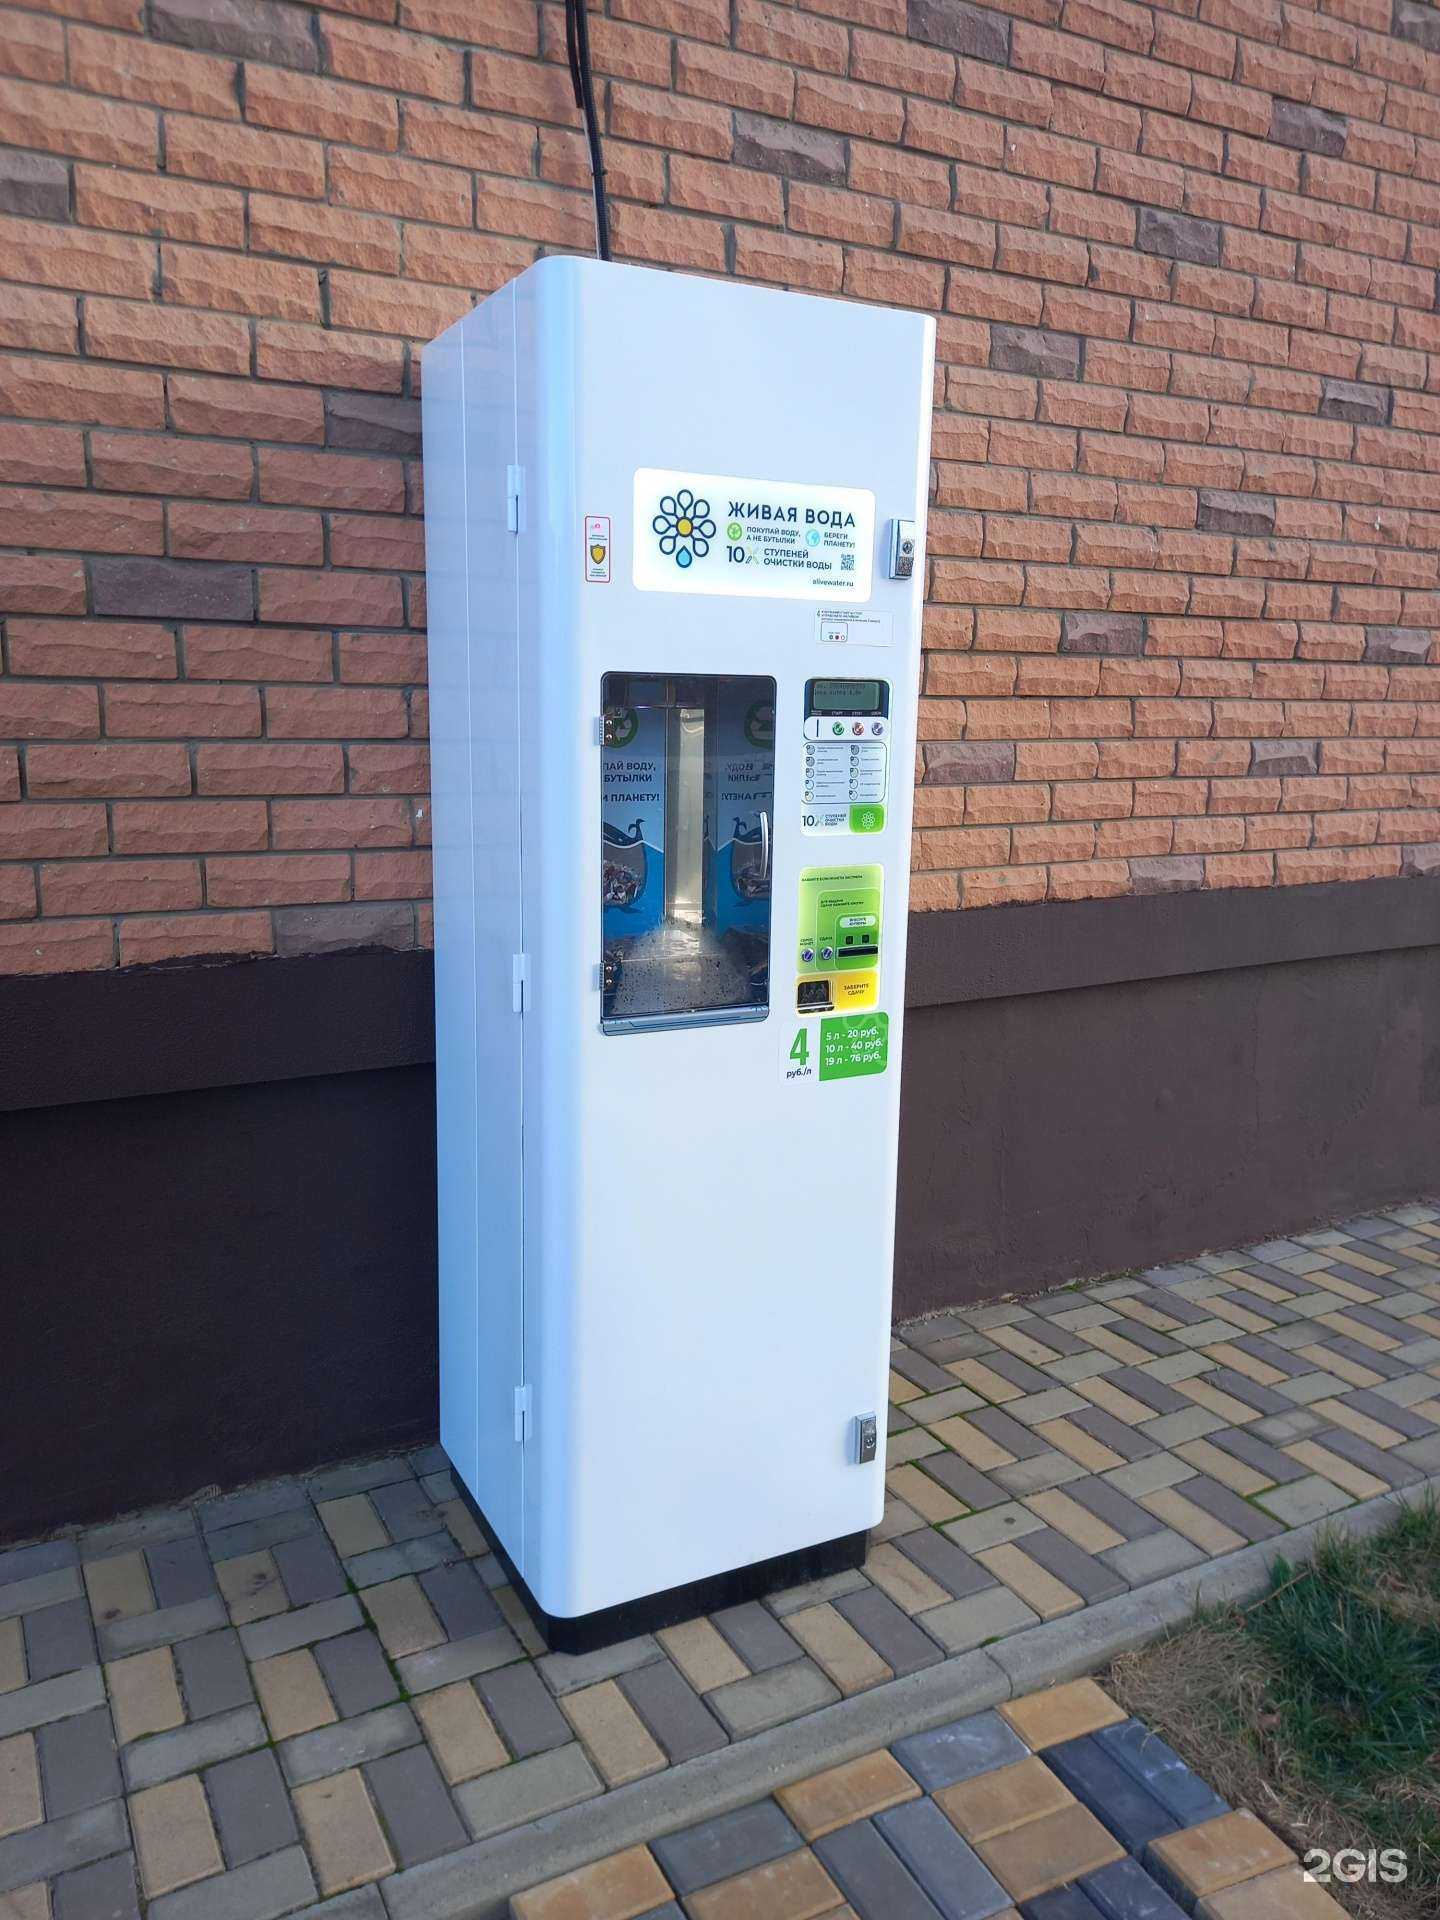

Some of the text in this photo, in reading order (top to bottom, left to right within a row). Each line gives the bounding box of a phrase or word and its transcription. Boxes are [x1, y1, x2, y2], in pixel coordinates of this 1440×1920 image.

[728, 501, 855, 528] ЖИВАЯ ВОДА
[746, 526, 801, 537] ПОКУПАЙ ВОДУ,
[824, 532, 848, 540] БЕРЕГИ
[763, 536, 796, 545] БУТЫЛКИ
[726, 546, 745, 563] 10
[764, 548, 809, 559] СТУПЕНЕЙ
[763, 558, 832, 570] ОЧИСТКИ ВОДЫ
[812, 579, 854, 587] alivewater.ru
[626, 762, 656, 771] ВОДУ,
[604, 774, 652, 782] БУТЫЛКИ
[611, 793, 660, 802] ПЛАНЕТУ!
[802, 815, 815, 827] 10
[826, 1032, 832, 1040] 5
[847, 1029, 858, 1038] 20
[860, 1026, 879, 1037] руб.
[789, 1028, 809, 1065] 4
[826, 1044, 835, 1053] 10
[851, 1041, 863, 1050] 40
[864, 1039, 883, 1050] руб.
[826, 1057, 834, 1066] 19
[850, 1054, 861, 1062] 76
[863, 1051, 881, 1062] руб.
[786, 1067, 812, 1078] руб./л
